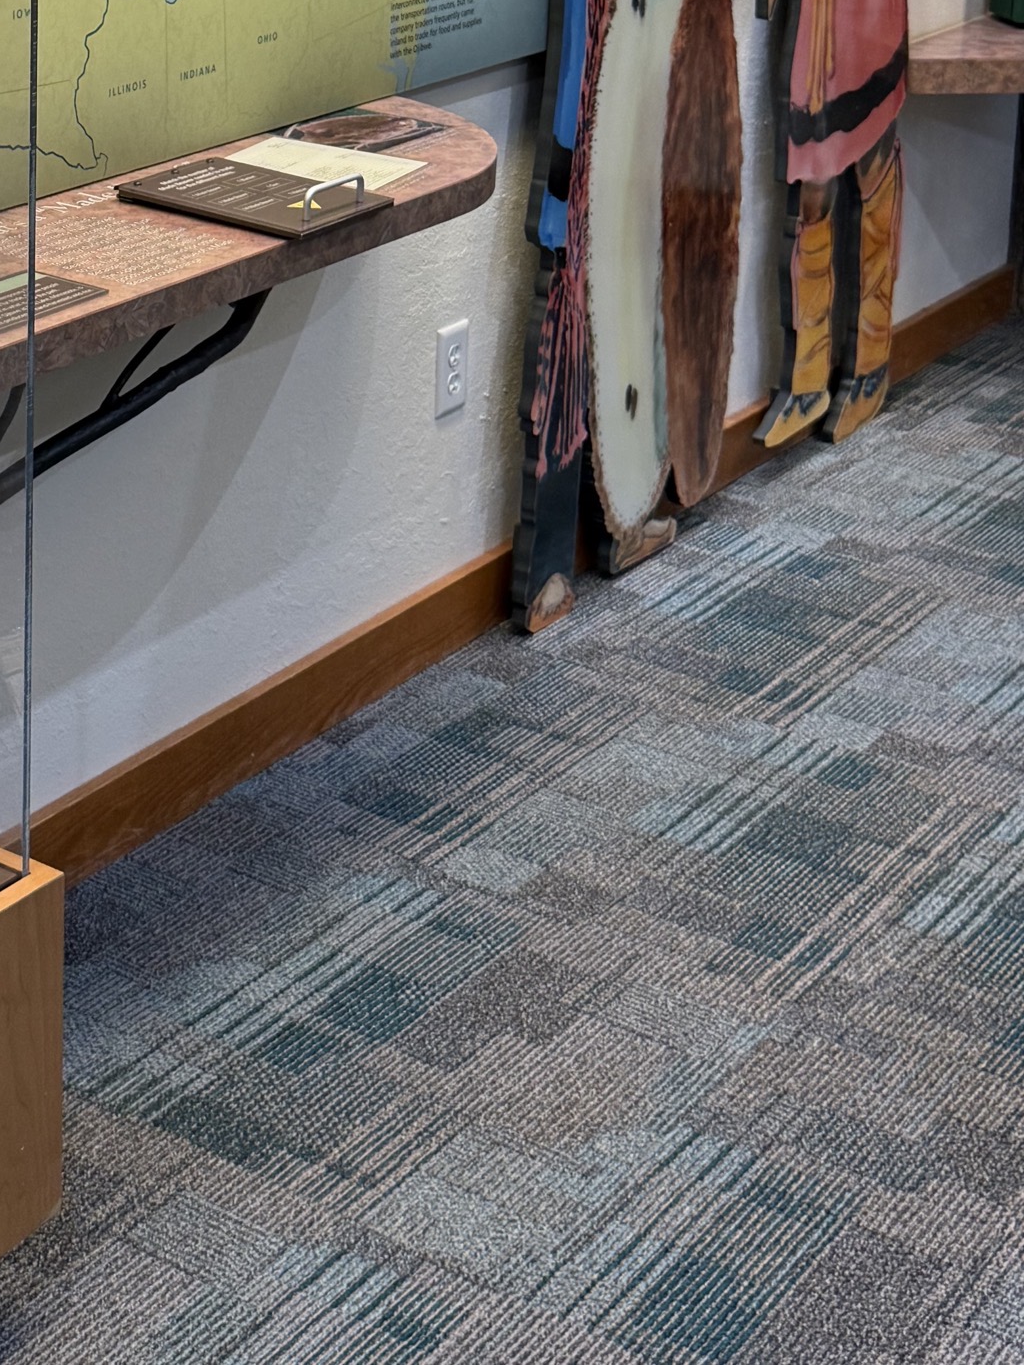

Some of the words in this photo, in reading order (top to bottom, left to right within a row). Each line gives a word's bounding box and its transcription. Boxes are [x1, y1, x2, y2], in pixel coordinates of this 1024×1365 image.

[257, 32, 279, 45] OHIO
[179, 64, 218, 83] INDIANA
[108, 78, 148, 98] ILLINOIS
